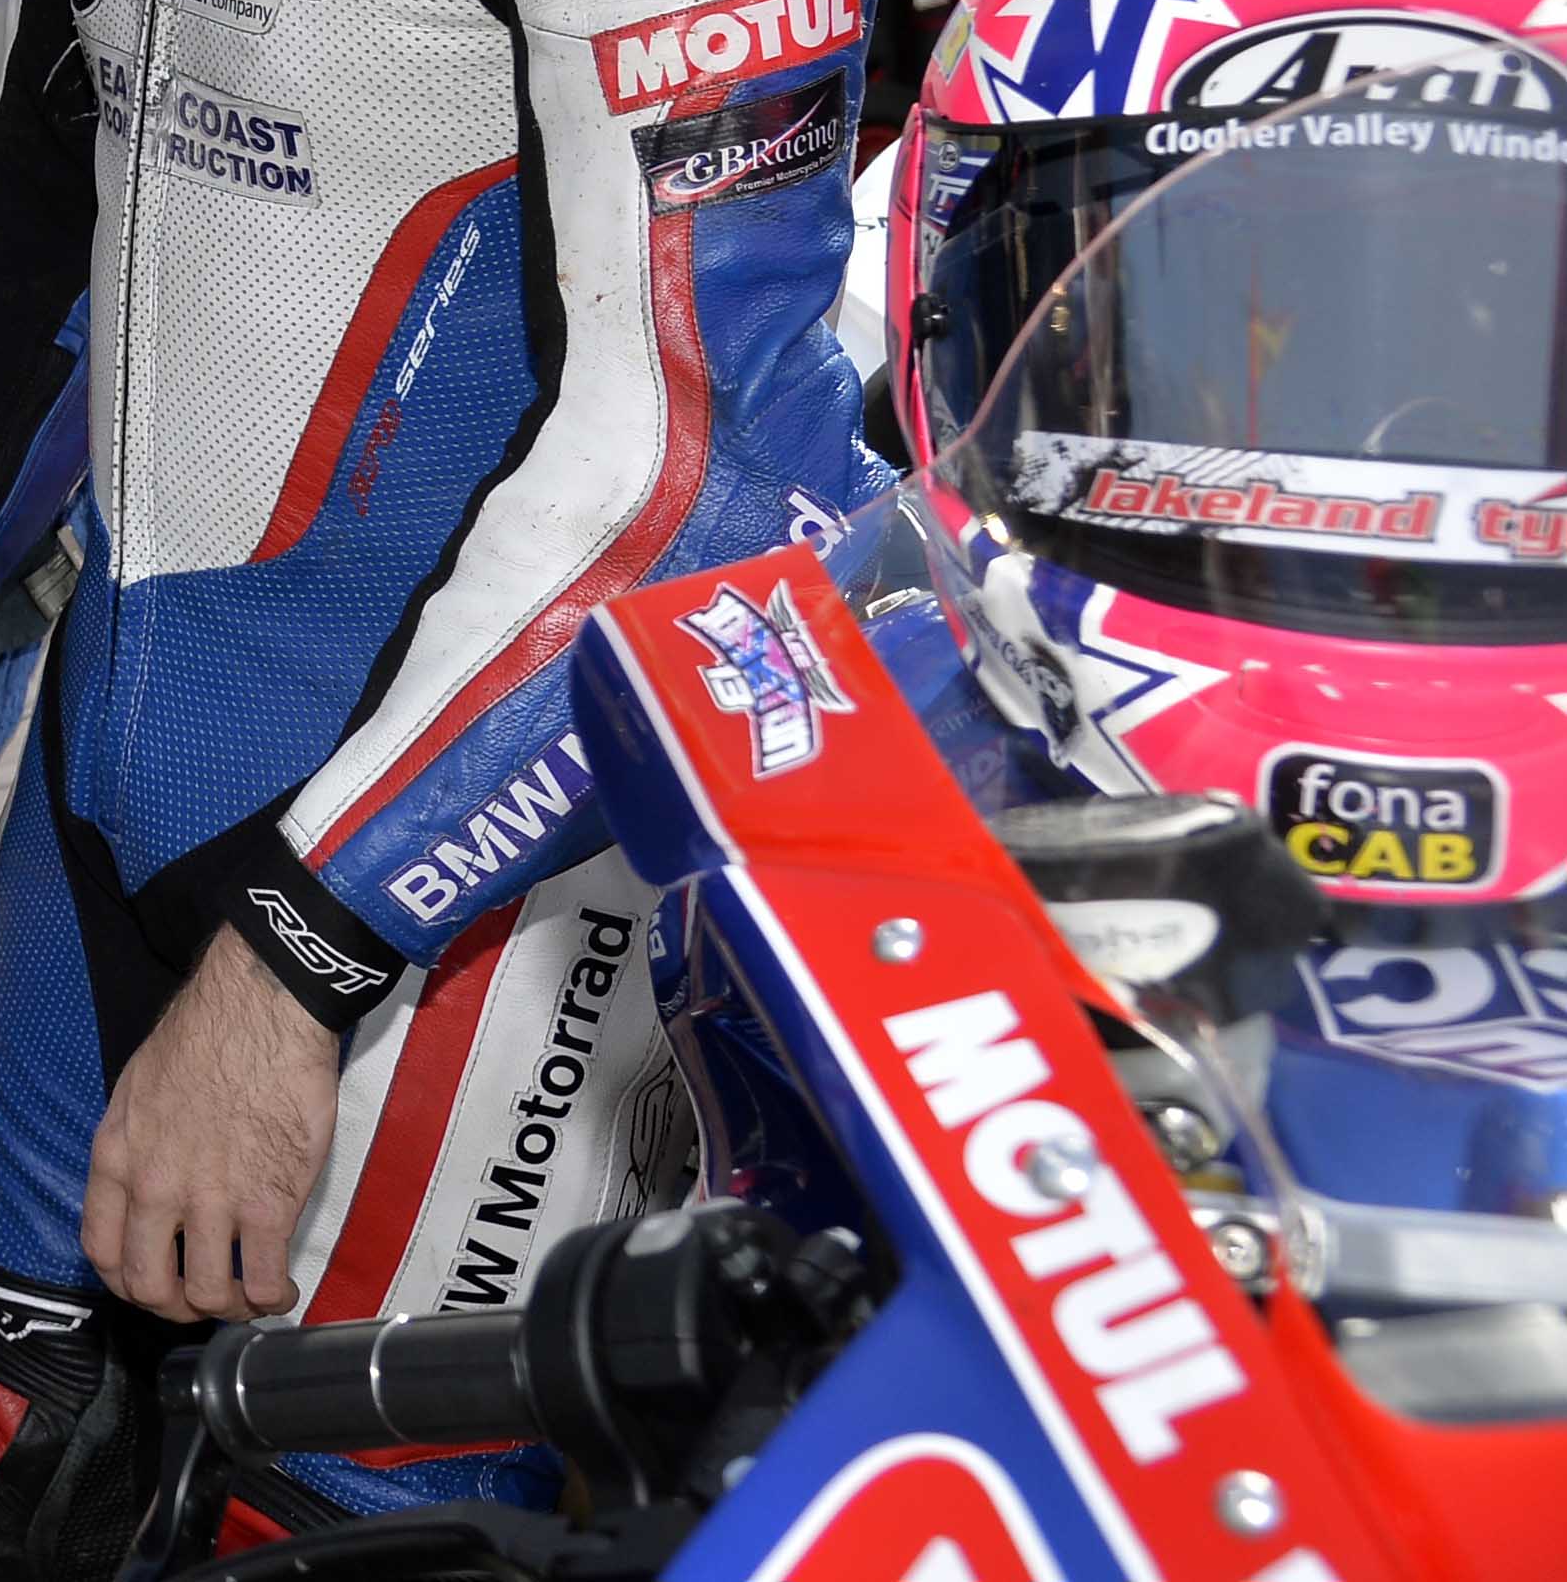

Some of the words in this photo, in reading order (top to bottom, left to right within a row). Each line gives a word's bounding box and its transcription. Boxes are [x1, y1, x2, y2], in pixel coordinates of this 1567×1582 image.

[177, 90, 302, 158] COAST
[684, 117, 838, 184] GBRacing
[1145, 117, 1297, 157] Clogher
[1300, 112, 1435, 154] Valley
[735, 176, 775, 193] Premier
[1086, 468, 1442, 543] lakeland
[1297, 763, 1467, 831] fona
[385, 759, 574, 923] BMW
[1285, 823, 1478, 882] CAB
[247, 888, 388, 995] RST
[475, 907, 634, 1232] Motorrad
[882, 988, 1249, 1467] MOTUL
[438, 1238, 520, 1312] W
